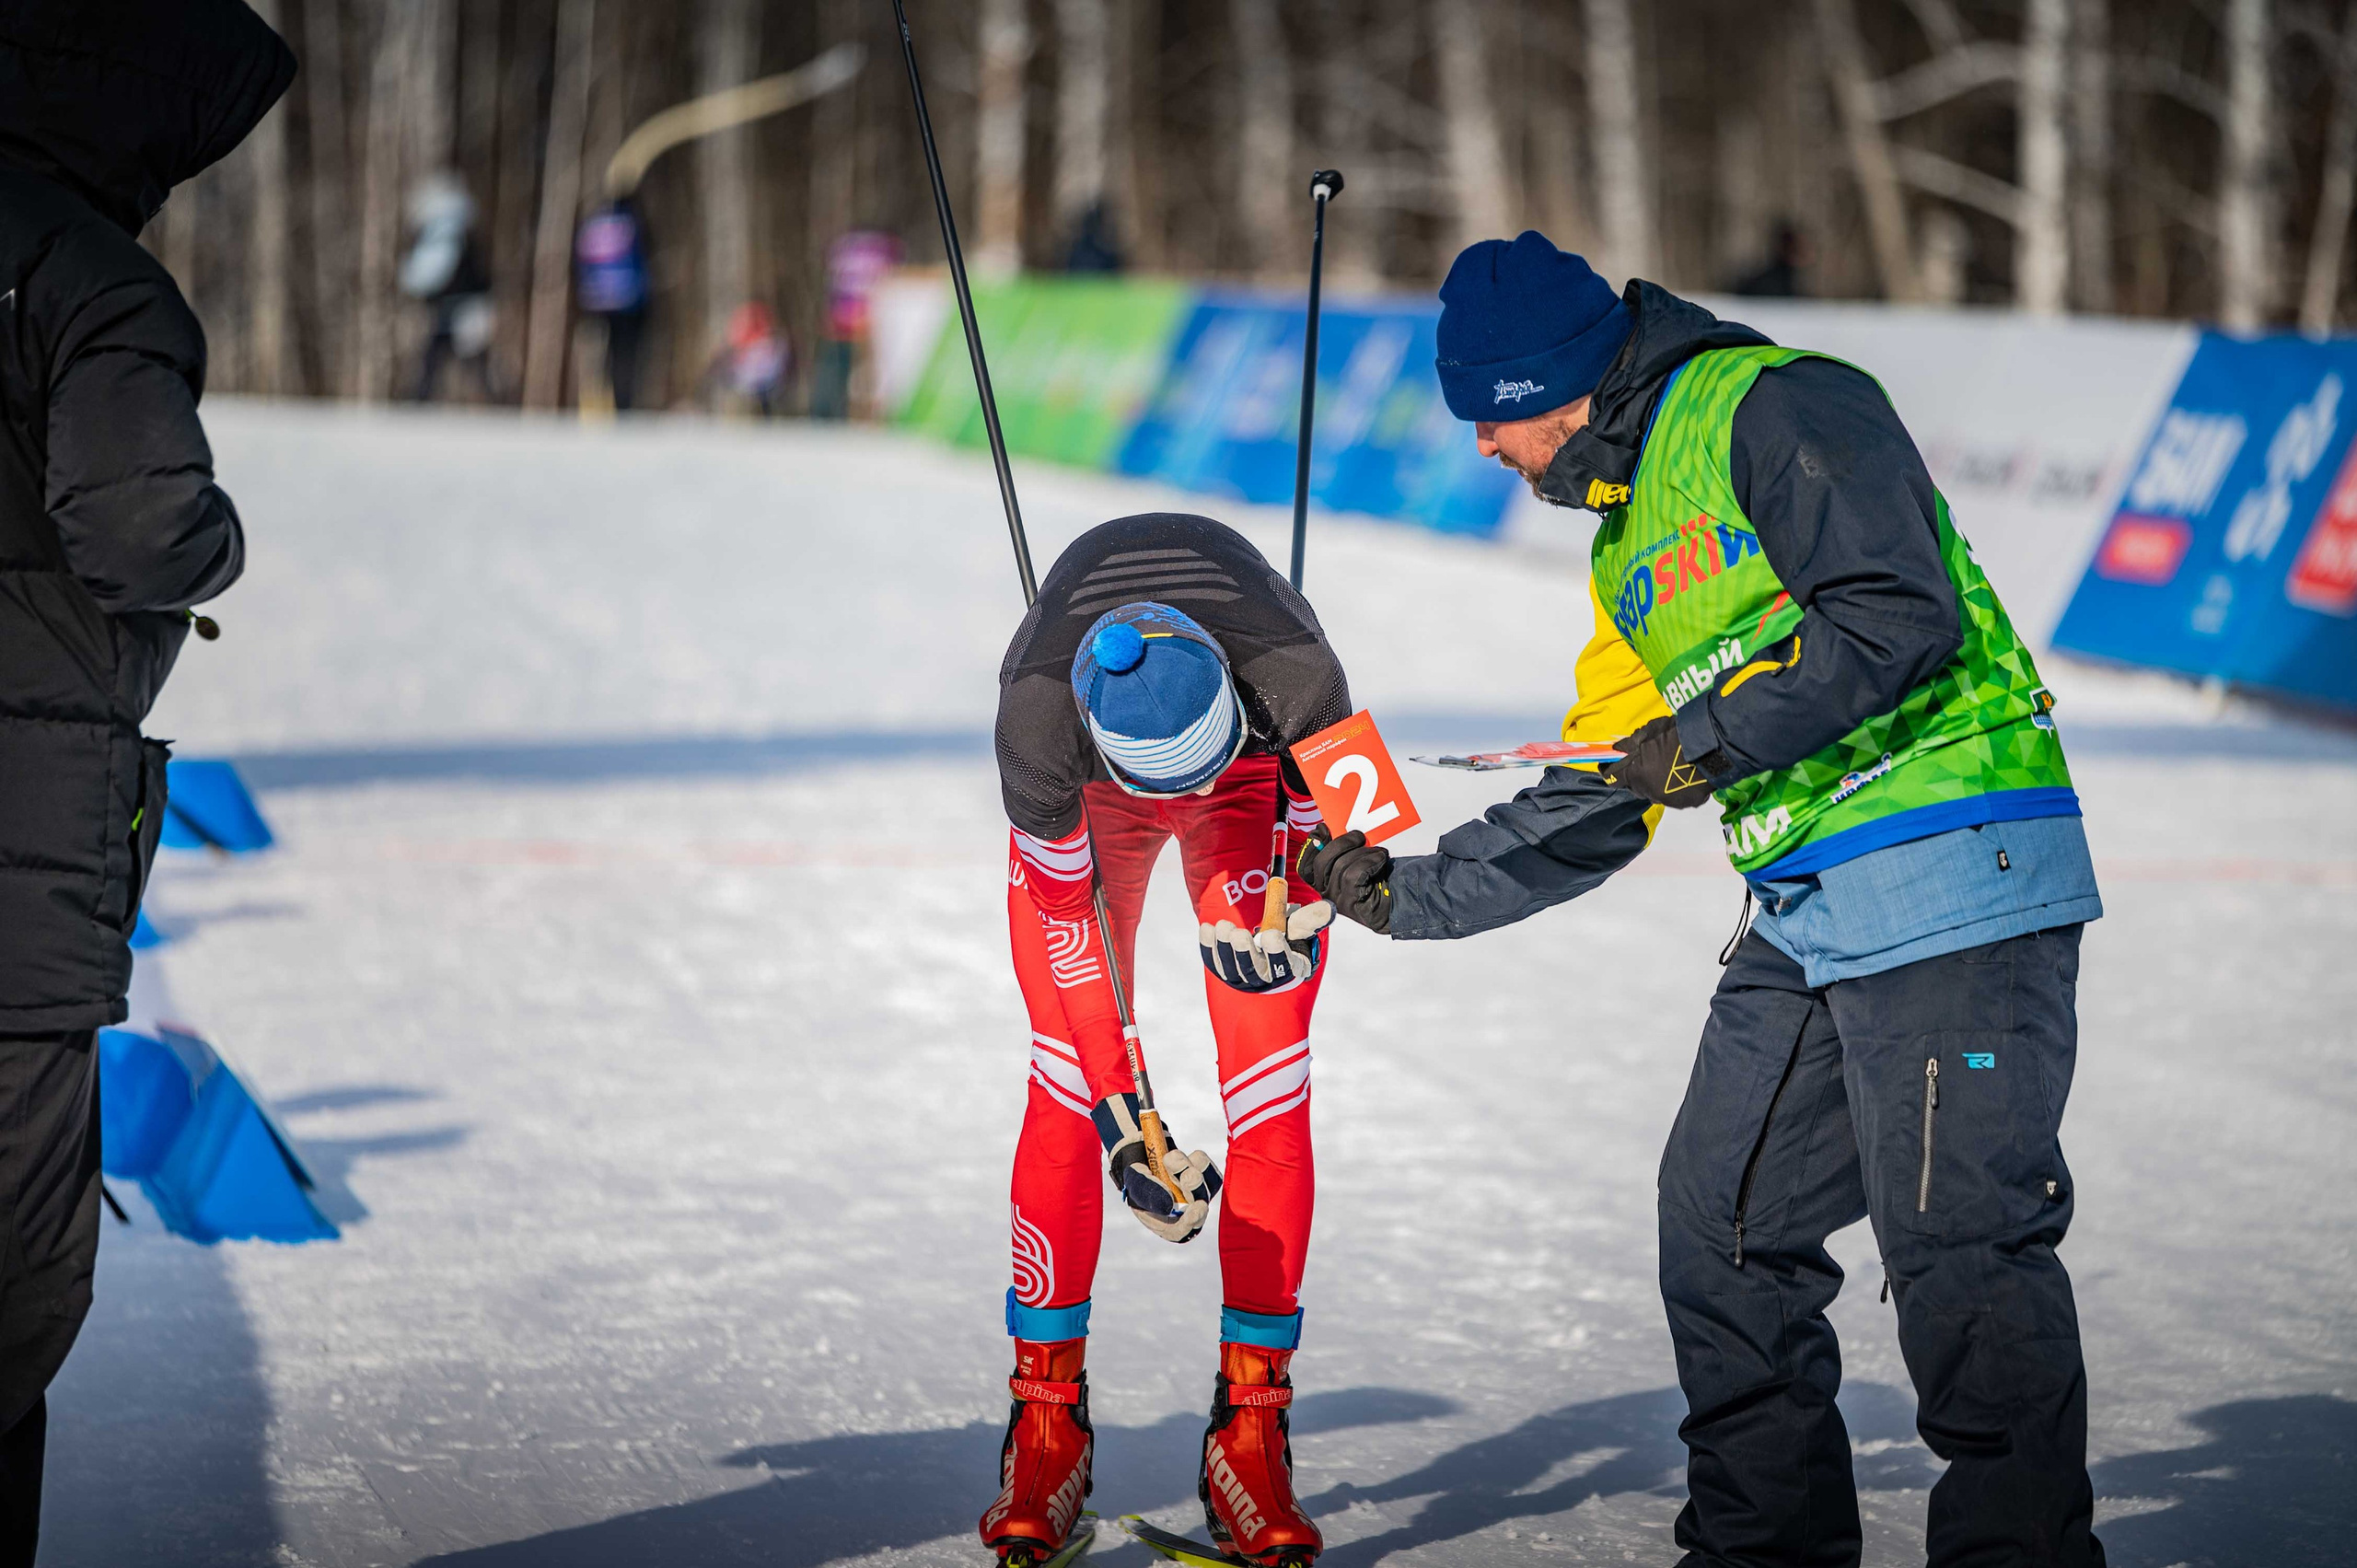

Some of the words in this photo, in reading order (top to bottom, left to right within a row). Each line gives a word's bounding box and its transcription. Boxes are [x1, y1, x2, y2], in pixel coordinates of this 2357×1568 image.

[1323, 753, 1401, 836] 2
[1011, 1378, 1065, 1404] alpina
[1046, 1432, 1092, 1539] alpin
